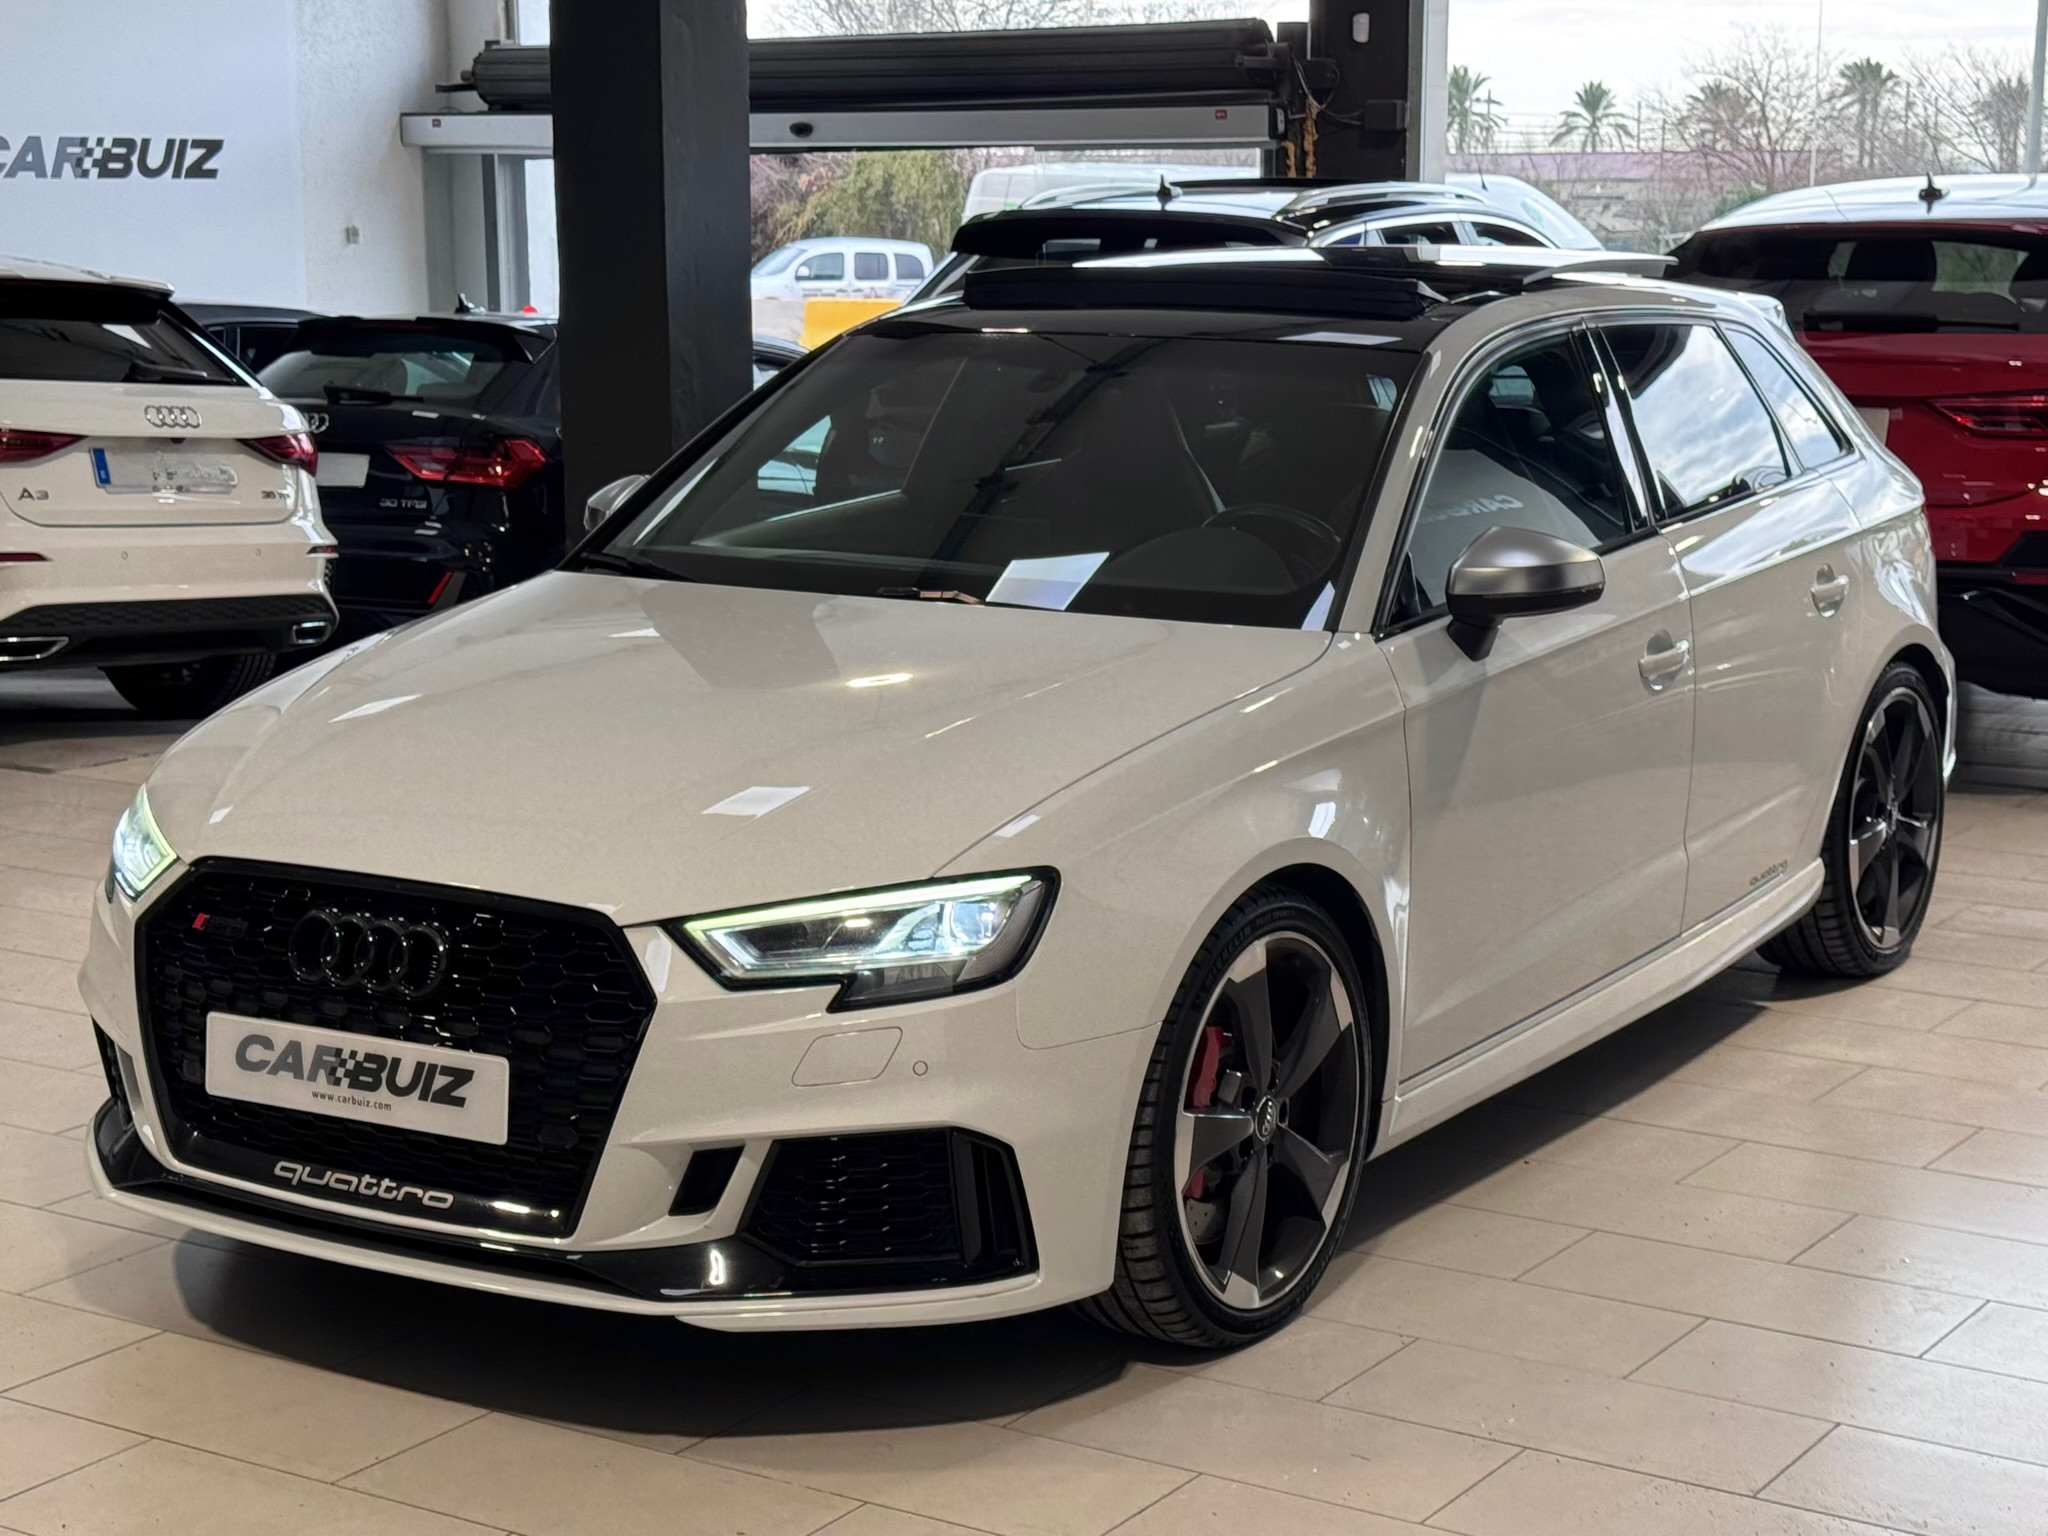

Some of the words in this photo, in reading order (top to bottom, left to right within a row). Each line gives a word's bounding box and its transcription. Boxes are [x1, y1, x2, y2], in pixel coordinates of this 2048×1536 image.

[0, 136, 224, 180] ARBUIZ
[311, 1090, 393, 1112] www.carbuiz.com
[273, 1160, 455, 1210] quattro
